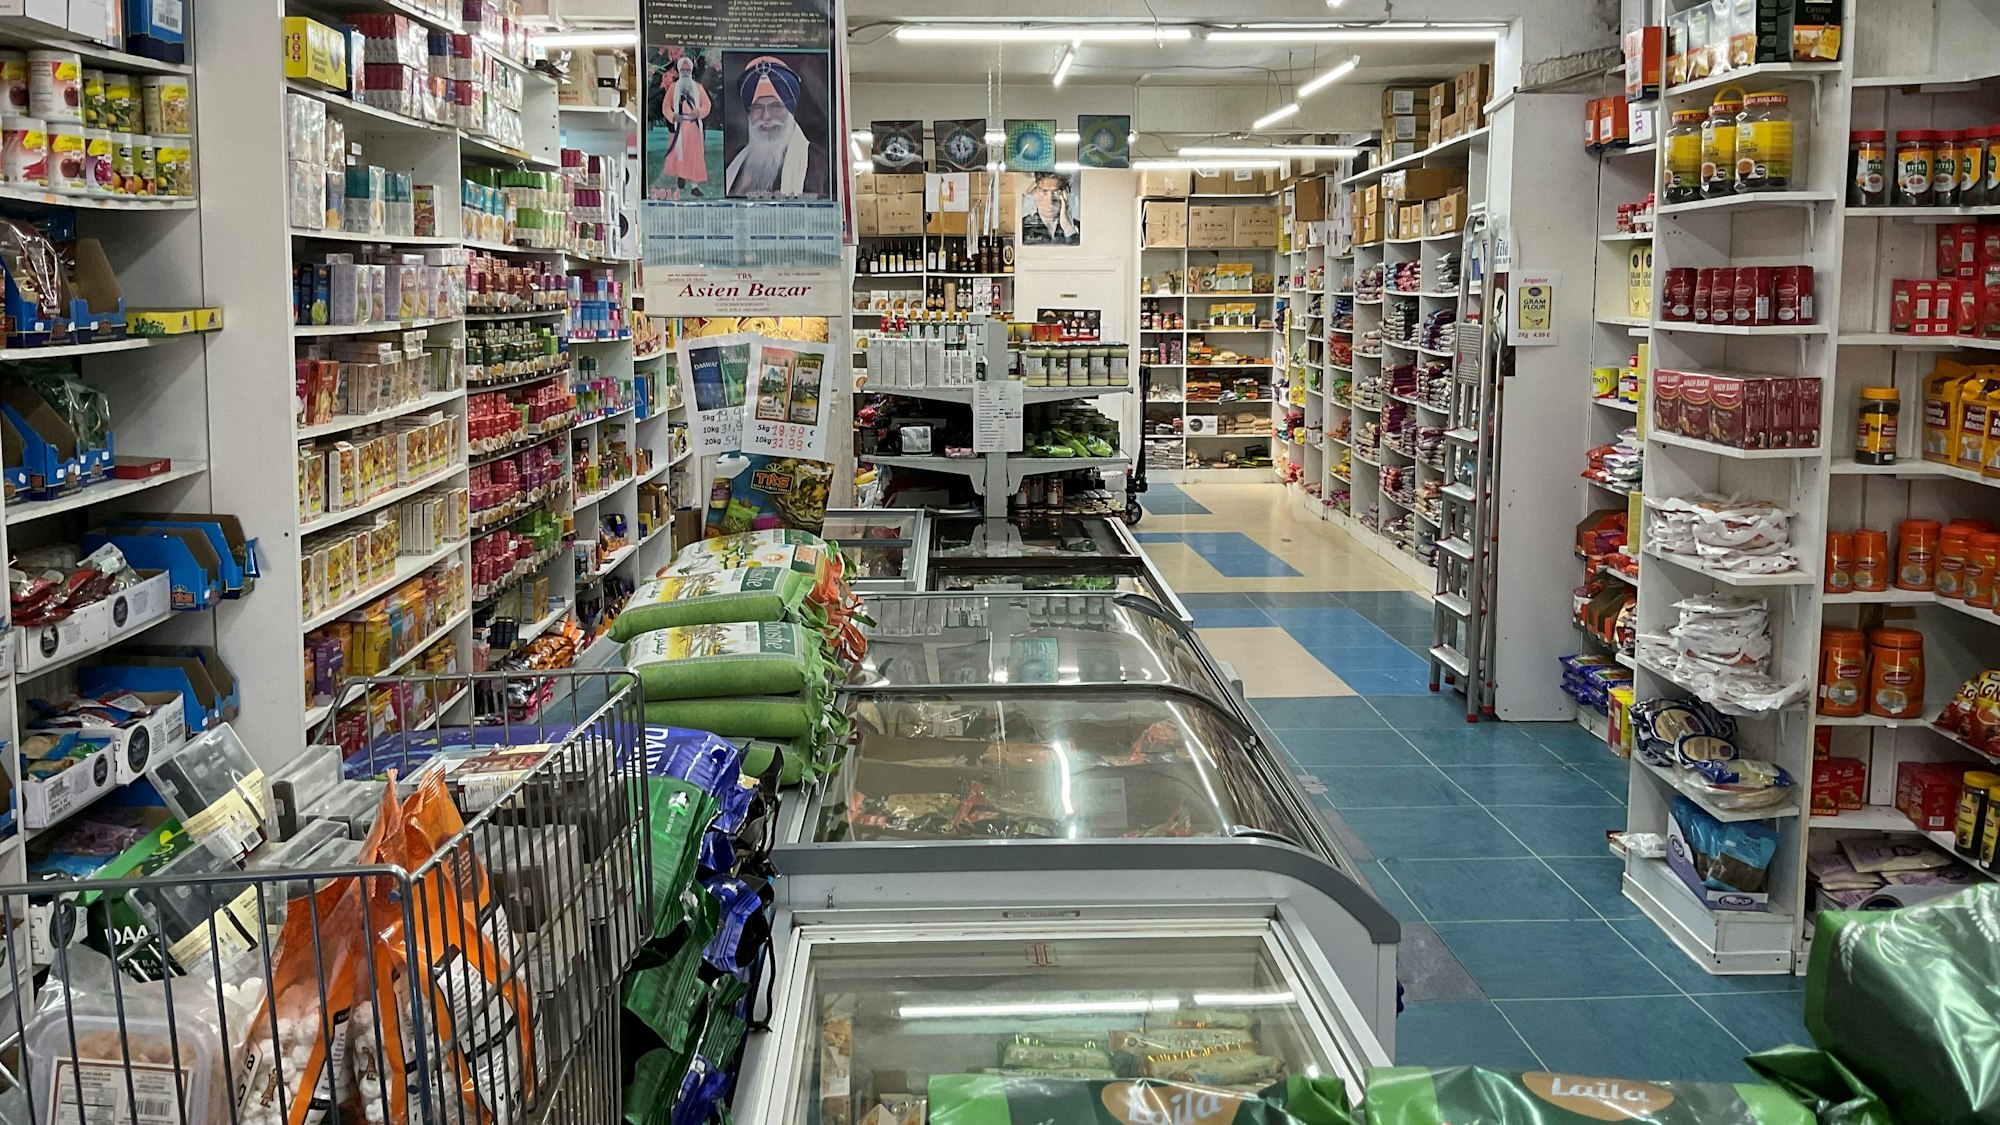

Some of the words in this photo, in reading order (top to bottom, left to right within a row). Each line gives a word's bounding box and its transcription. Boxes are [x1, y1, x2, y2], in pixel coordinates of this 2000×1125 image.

[736, 272, 752, 280] TRS
[678, 282, 740, 298] Asien
[748, 282, 812, 298] Bazar
[702, 414, 715, 422] 5kg
[703, 426, 720, 434] 10kg
[809, 429, 816, 437] €
[704, 438, 722, 446] 20kg
[756, 472, 791, 488] TRS
[1551, 1077, 1651, 1103] Laila
